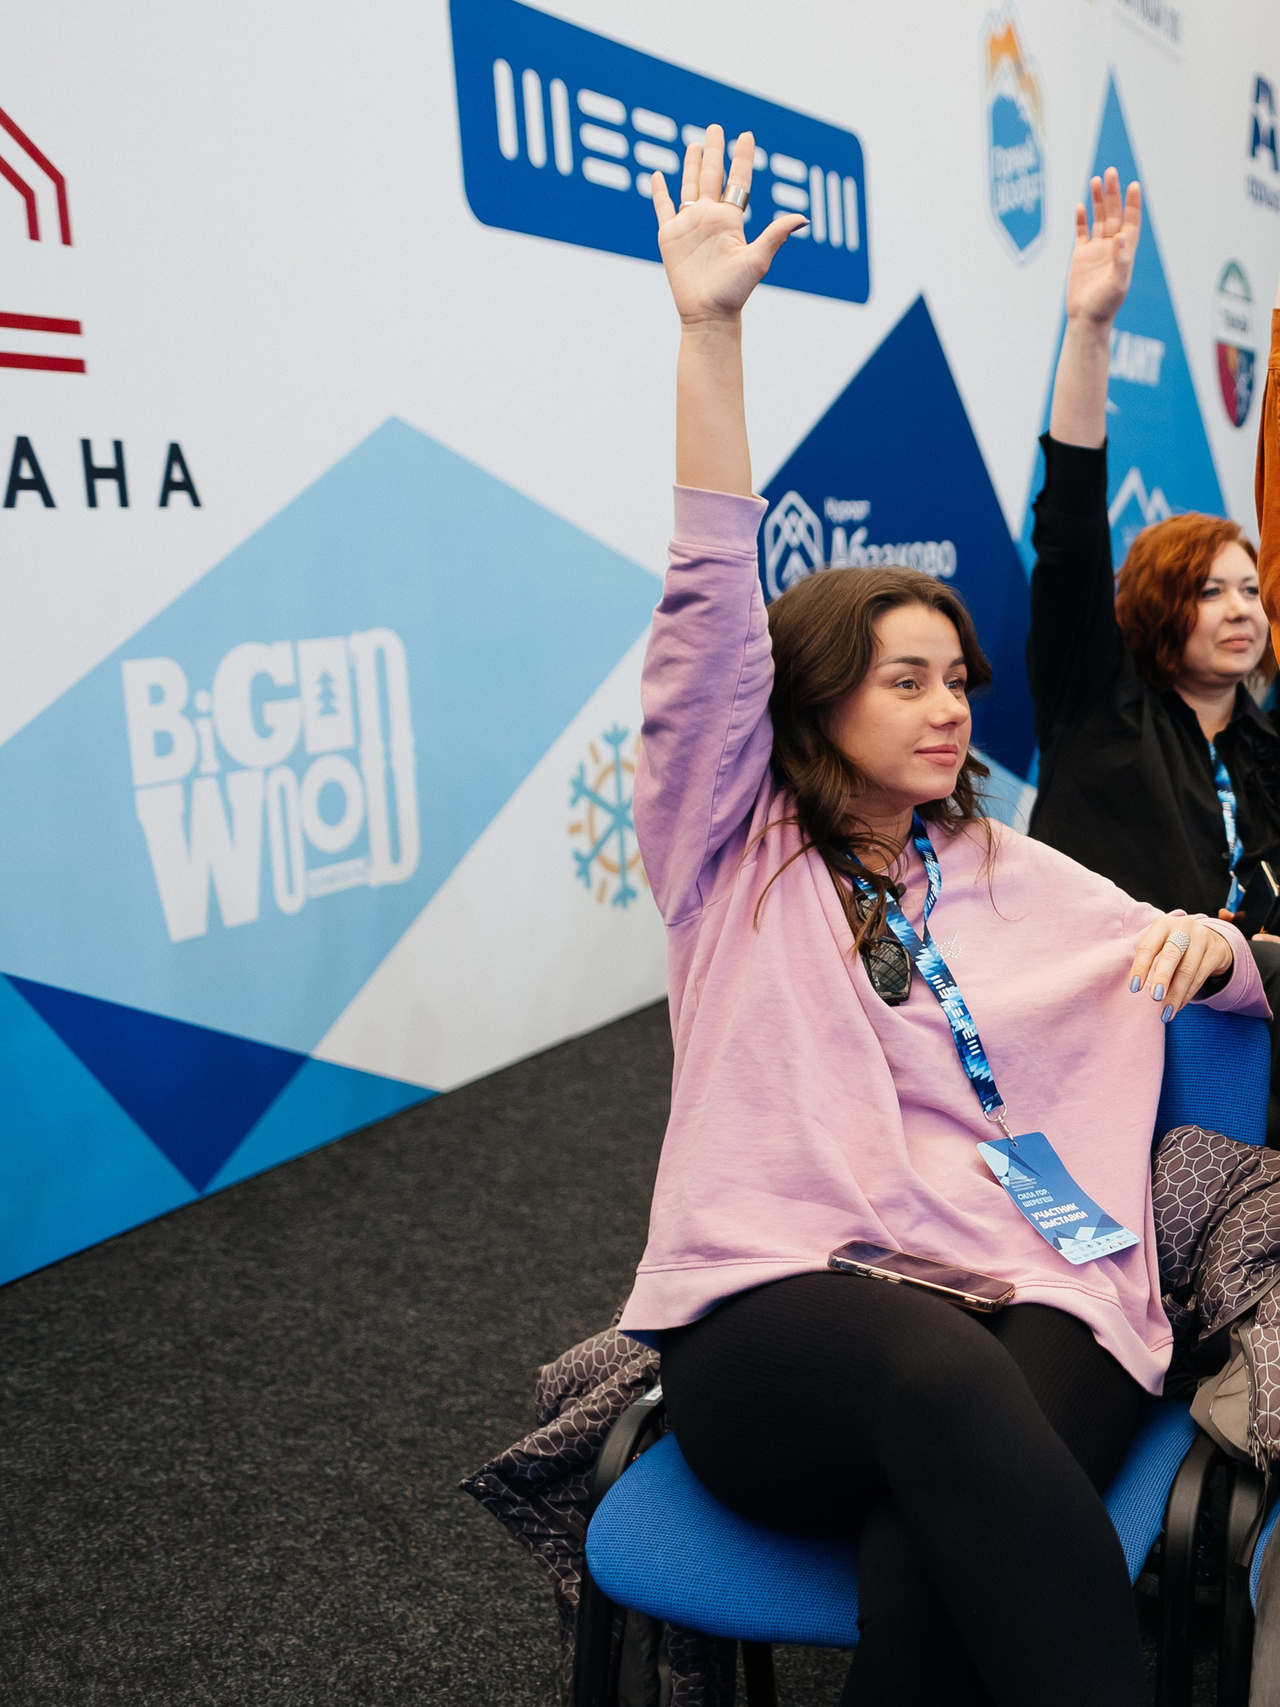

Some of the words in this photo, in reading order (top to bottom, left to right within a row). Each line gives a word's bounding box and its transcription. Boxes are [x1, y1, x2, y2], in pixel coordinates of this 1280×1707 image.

[1017, 1191, 1036, 1201] СИЛА
[1022, 1196, 1054, 1208] ШЕРЕГЕШ
[1031, 1203, 1079, 1220] УЧАСТНИК
[1039, 1211, 1088, 1229] ВЫСТАВКИ
